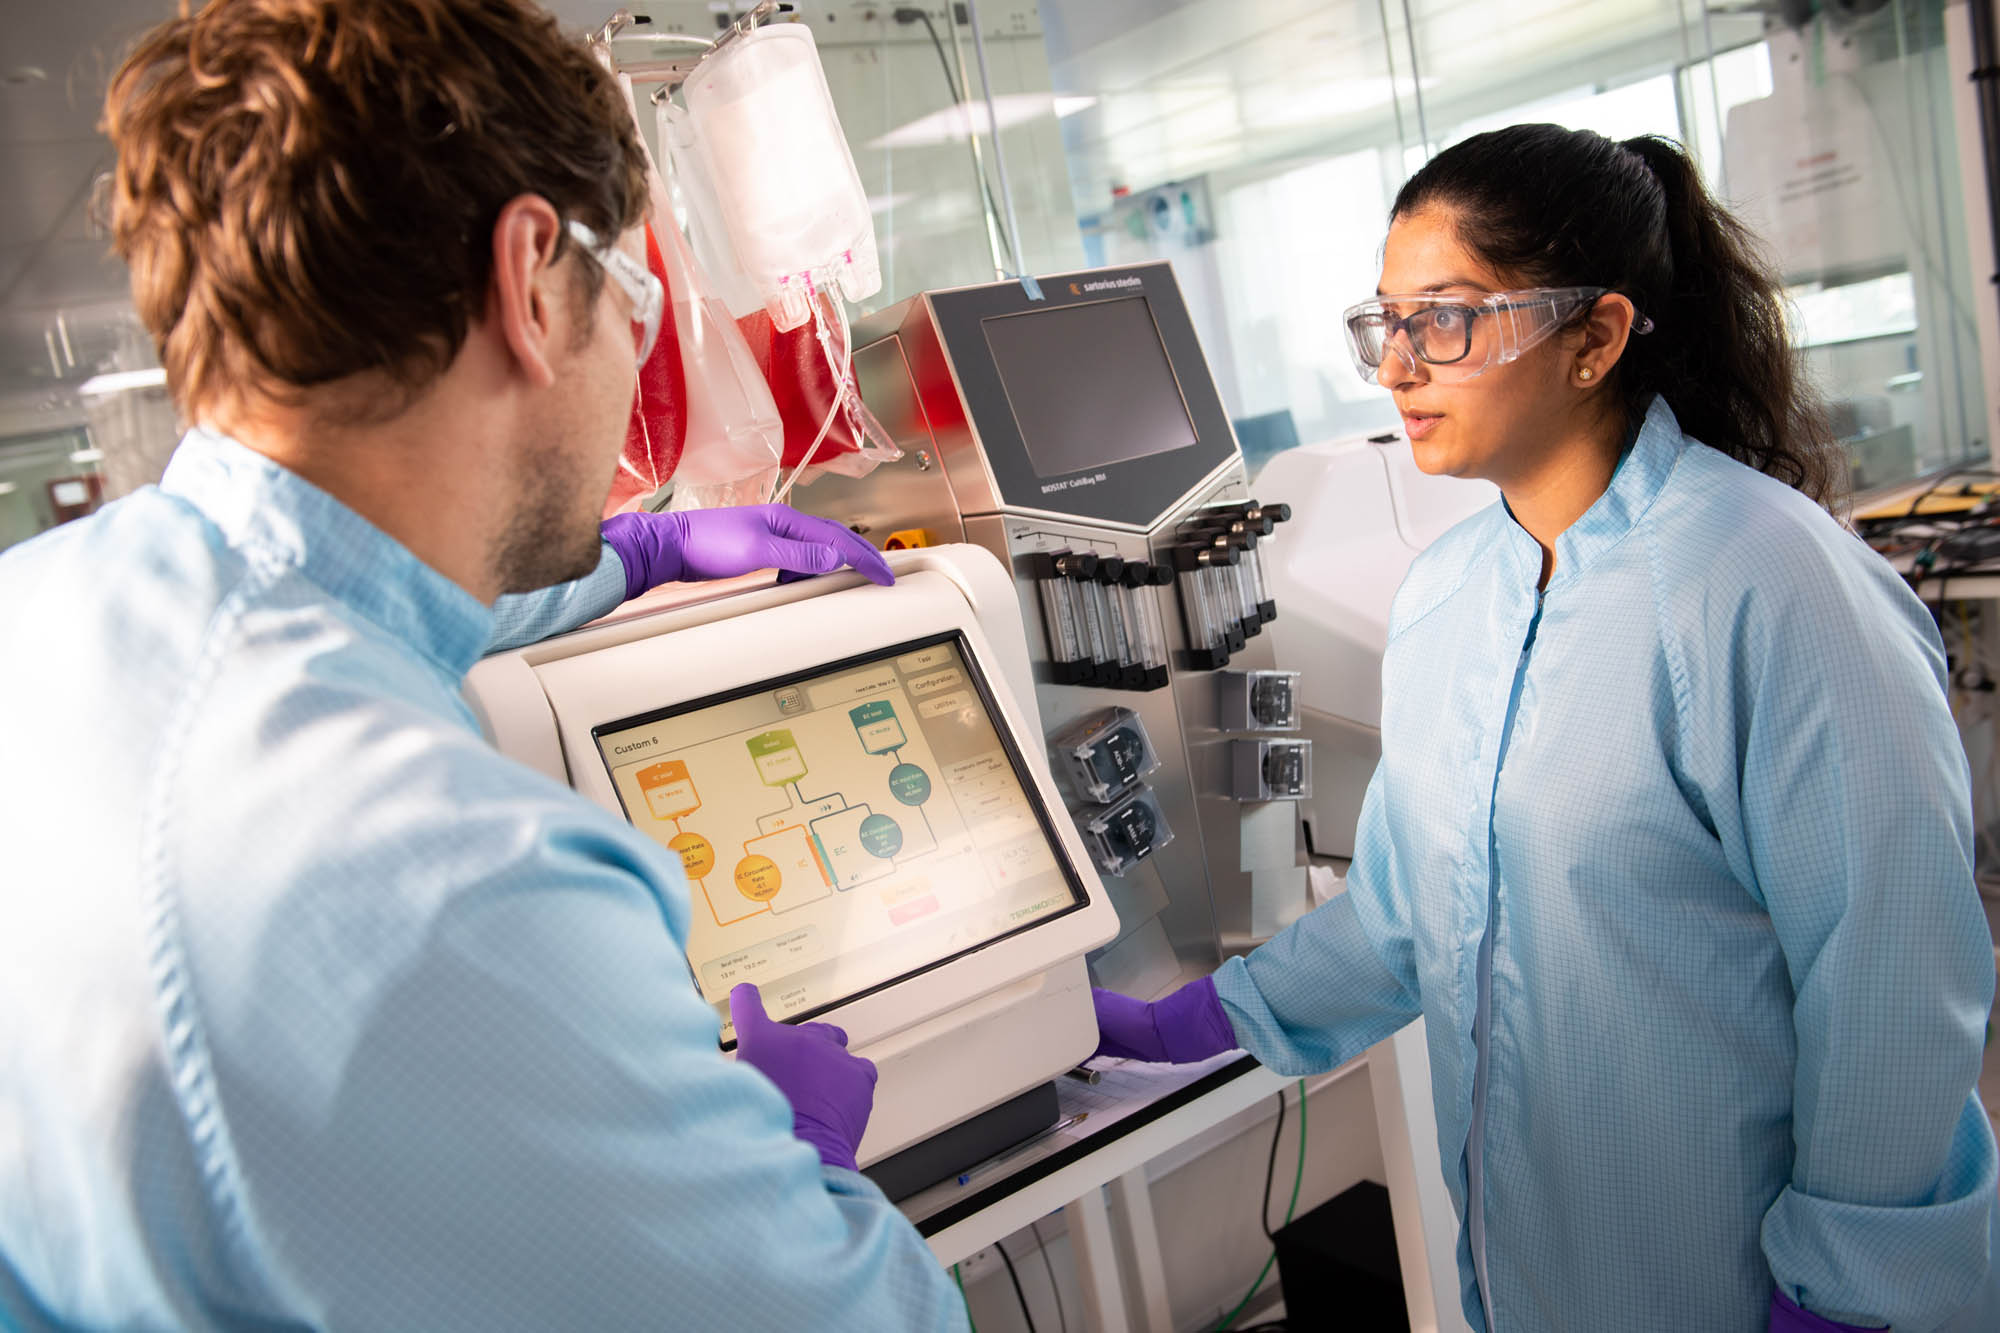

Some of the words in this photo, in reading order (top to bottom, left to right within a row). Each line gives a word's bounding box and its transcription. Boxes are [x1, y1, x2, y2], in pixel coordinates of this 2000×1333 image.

[1083, 279, 1116, 291] sartorius
[1116, 276, 1141, 288] stedim
[915, 674, 956, 690] Configuration
[614, 739, 652, 756] Custom
[652, 736, 660, 746] 6
[1113, 750, 1126, 771] ACID-1
[1127, 824, 1140, 846] BASE-1
[833, 846, 847, 856] EC
[744, 864, 773, 879] Circulation
